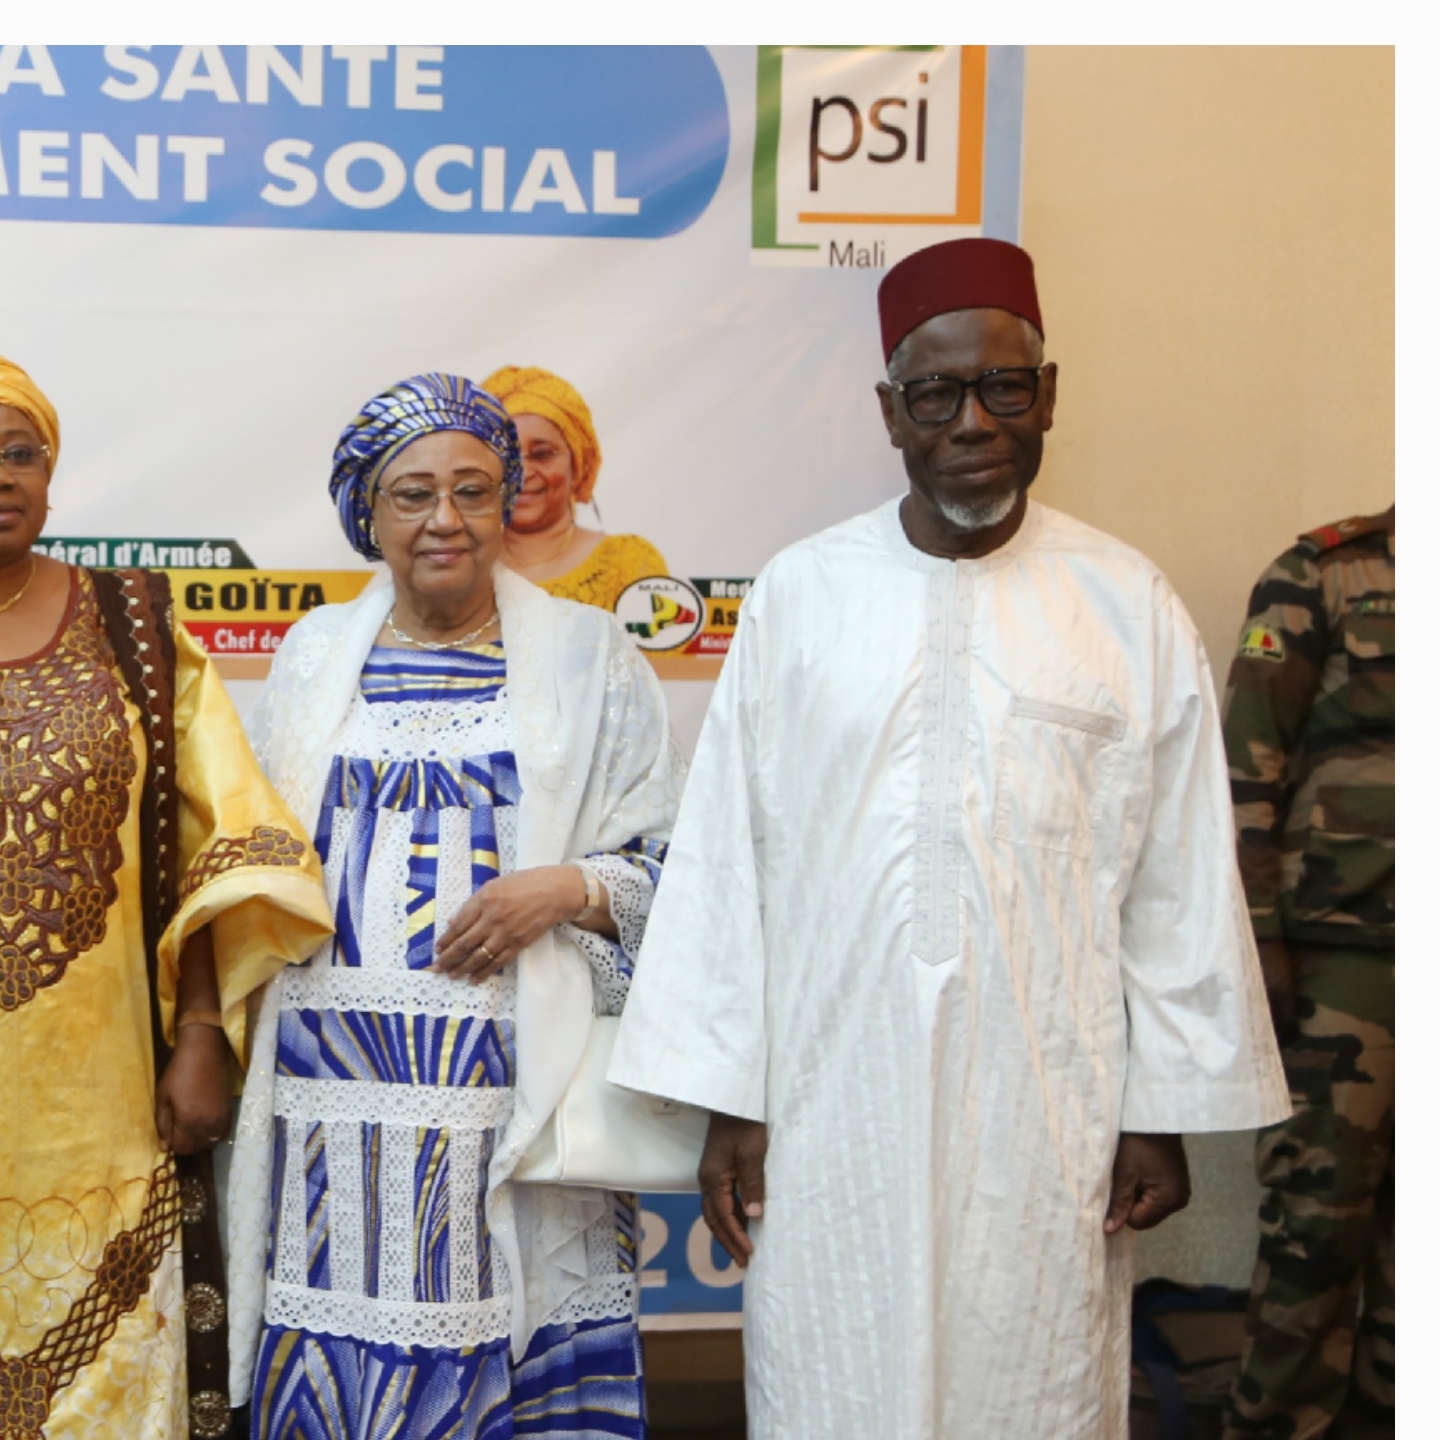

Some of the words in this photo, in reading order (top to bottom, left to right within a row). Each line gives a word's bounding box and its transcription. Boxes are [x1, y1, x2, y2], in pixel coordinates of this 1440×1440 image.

[809, 72, 929, 193] psi
[260, 138, 641, 216] SOCIAL
[828, 240, 886, 268] Mali
[113, 540, 233, 568] d'Armée
[184, 576, 328, 612] GOÏTA
[213, 628, 255, 650] Chef
